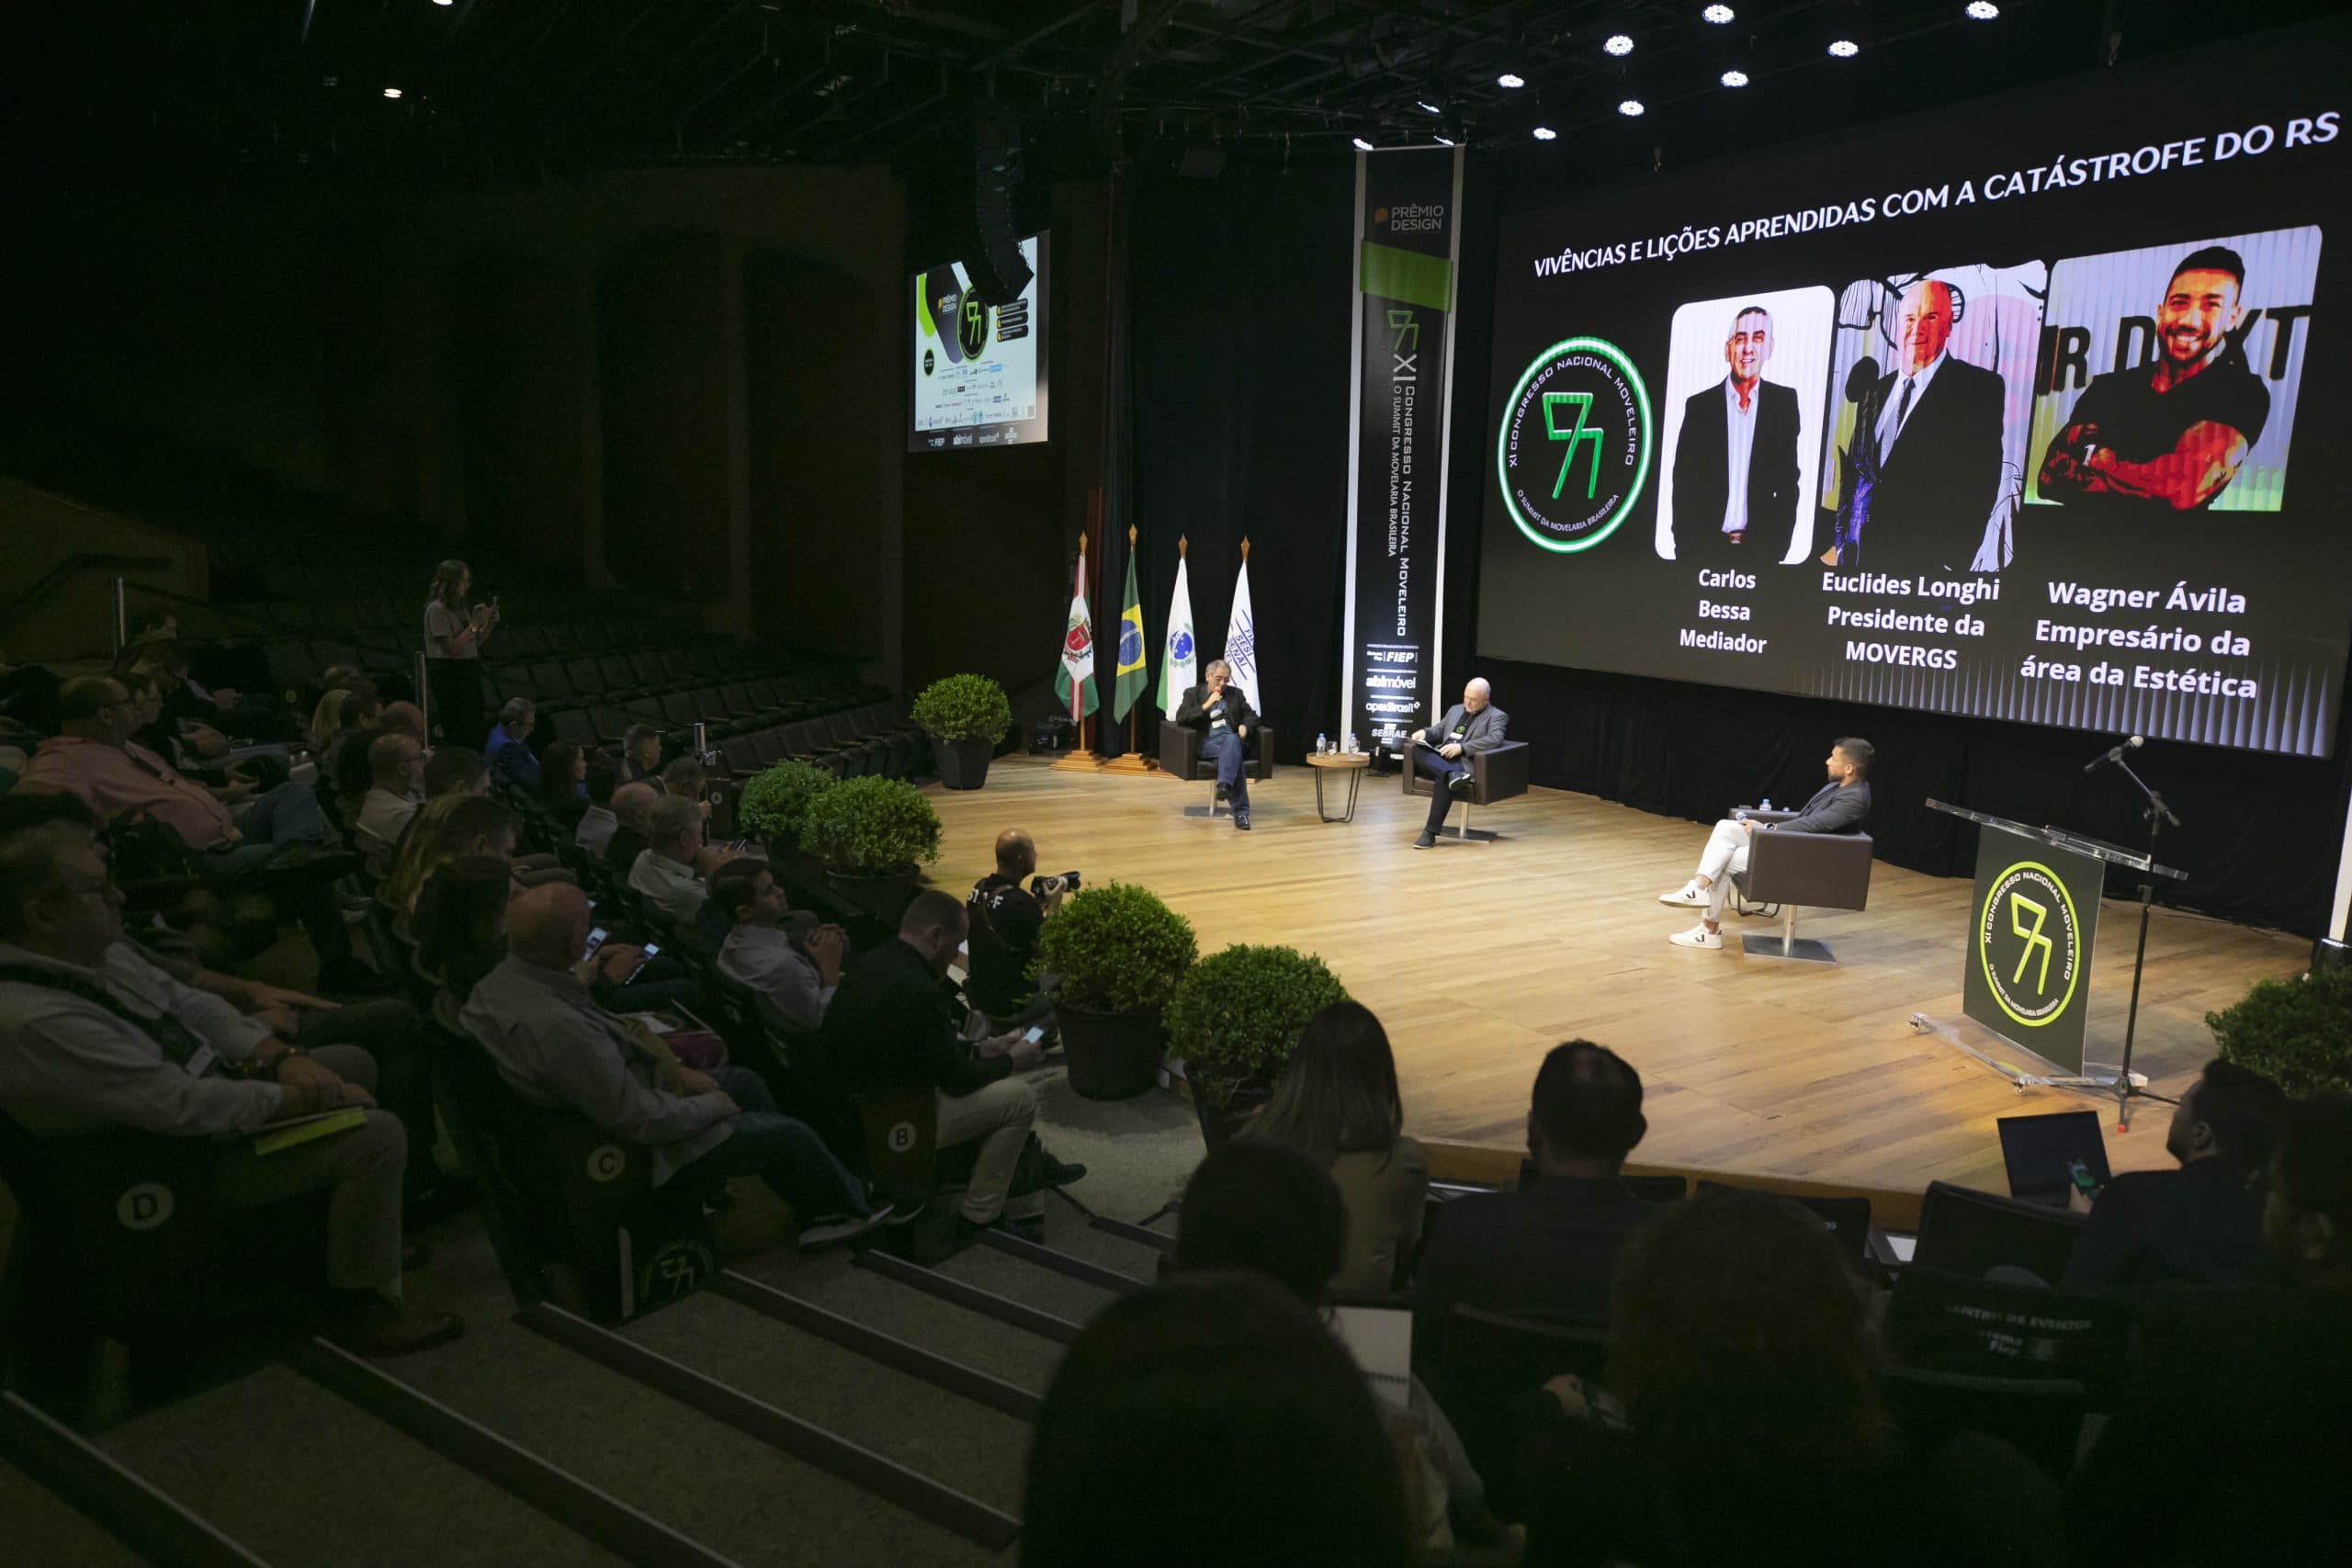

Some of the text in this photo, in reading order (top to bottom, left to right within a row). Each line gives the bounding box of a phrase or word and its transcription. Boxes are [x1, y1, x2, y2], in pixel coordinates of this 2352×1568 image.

[1534, 111, 2340, 277] VIVÊNCIAS E LIÇÕES APRENDIDAS COM A CATÁSTROFE DO RS
[1391, 219, 1442, 231] DESIGN
[1392, 204, 1444, 218] PRÊMIO
[1510, 355, 1636, 468] XI CONGRESSO NACIONAL MOVELEIRO
[1388, 386, 1402, 557] O SUMMIT DA MOVELARIA BRASILEIRA
[1393, 354, 1418, 637] XI CONGRESSO NACIONAL MOVELEIRO
[1521, 497, 1542, 521] SUMMIT
[1541, 517, 1550, 527] DA
[1550, 521, 1587, 532] MOVELARIA
[1587, 494, 1619, 525] BRASILEIRA
[1699, 569, 1757, 590] Carlos
[1822, 571, 2000, 605] Euclides Longhi
[1699, 600, 1750, 621] Bessa
[2048, 581, 2246, 614] Wagner Ávila
[1827, 606, 1985, 637] Presidente da
[1236, 634, 1254, 657] SESI
[1679, 628, 1767, 654] Mediador
[2035, 619, 2250, 657] Empresário da
[1386, 651, 1415, 663] FIEP
[1845, 641, 1958, 670] MOVERGS
[2020, 655, 2257, 699] área da Estética
[1984, 872, 2075, 981] XI CONGRESSO NACIONAL MOVELEIRO
[896, 1128, 909, 1147] B
[598, 1153, 616, 1174] C
[133, 1193, 158, 1221] D
